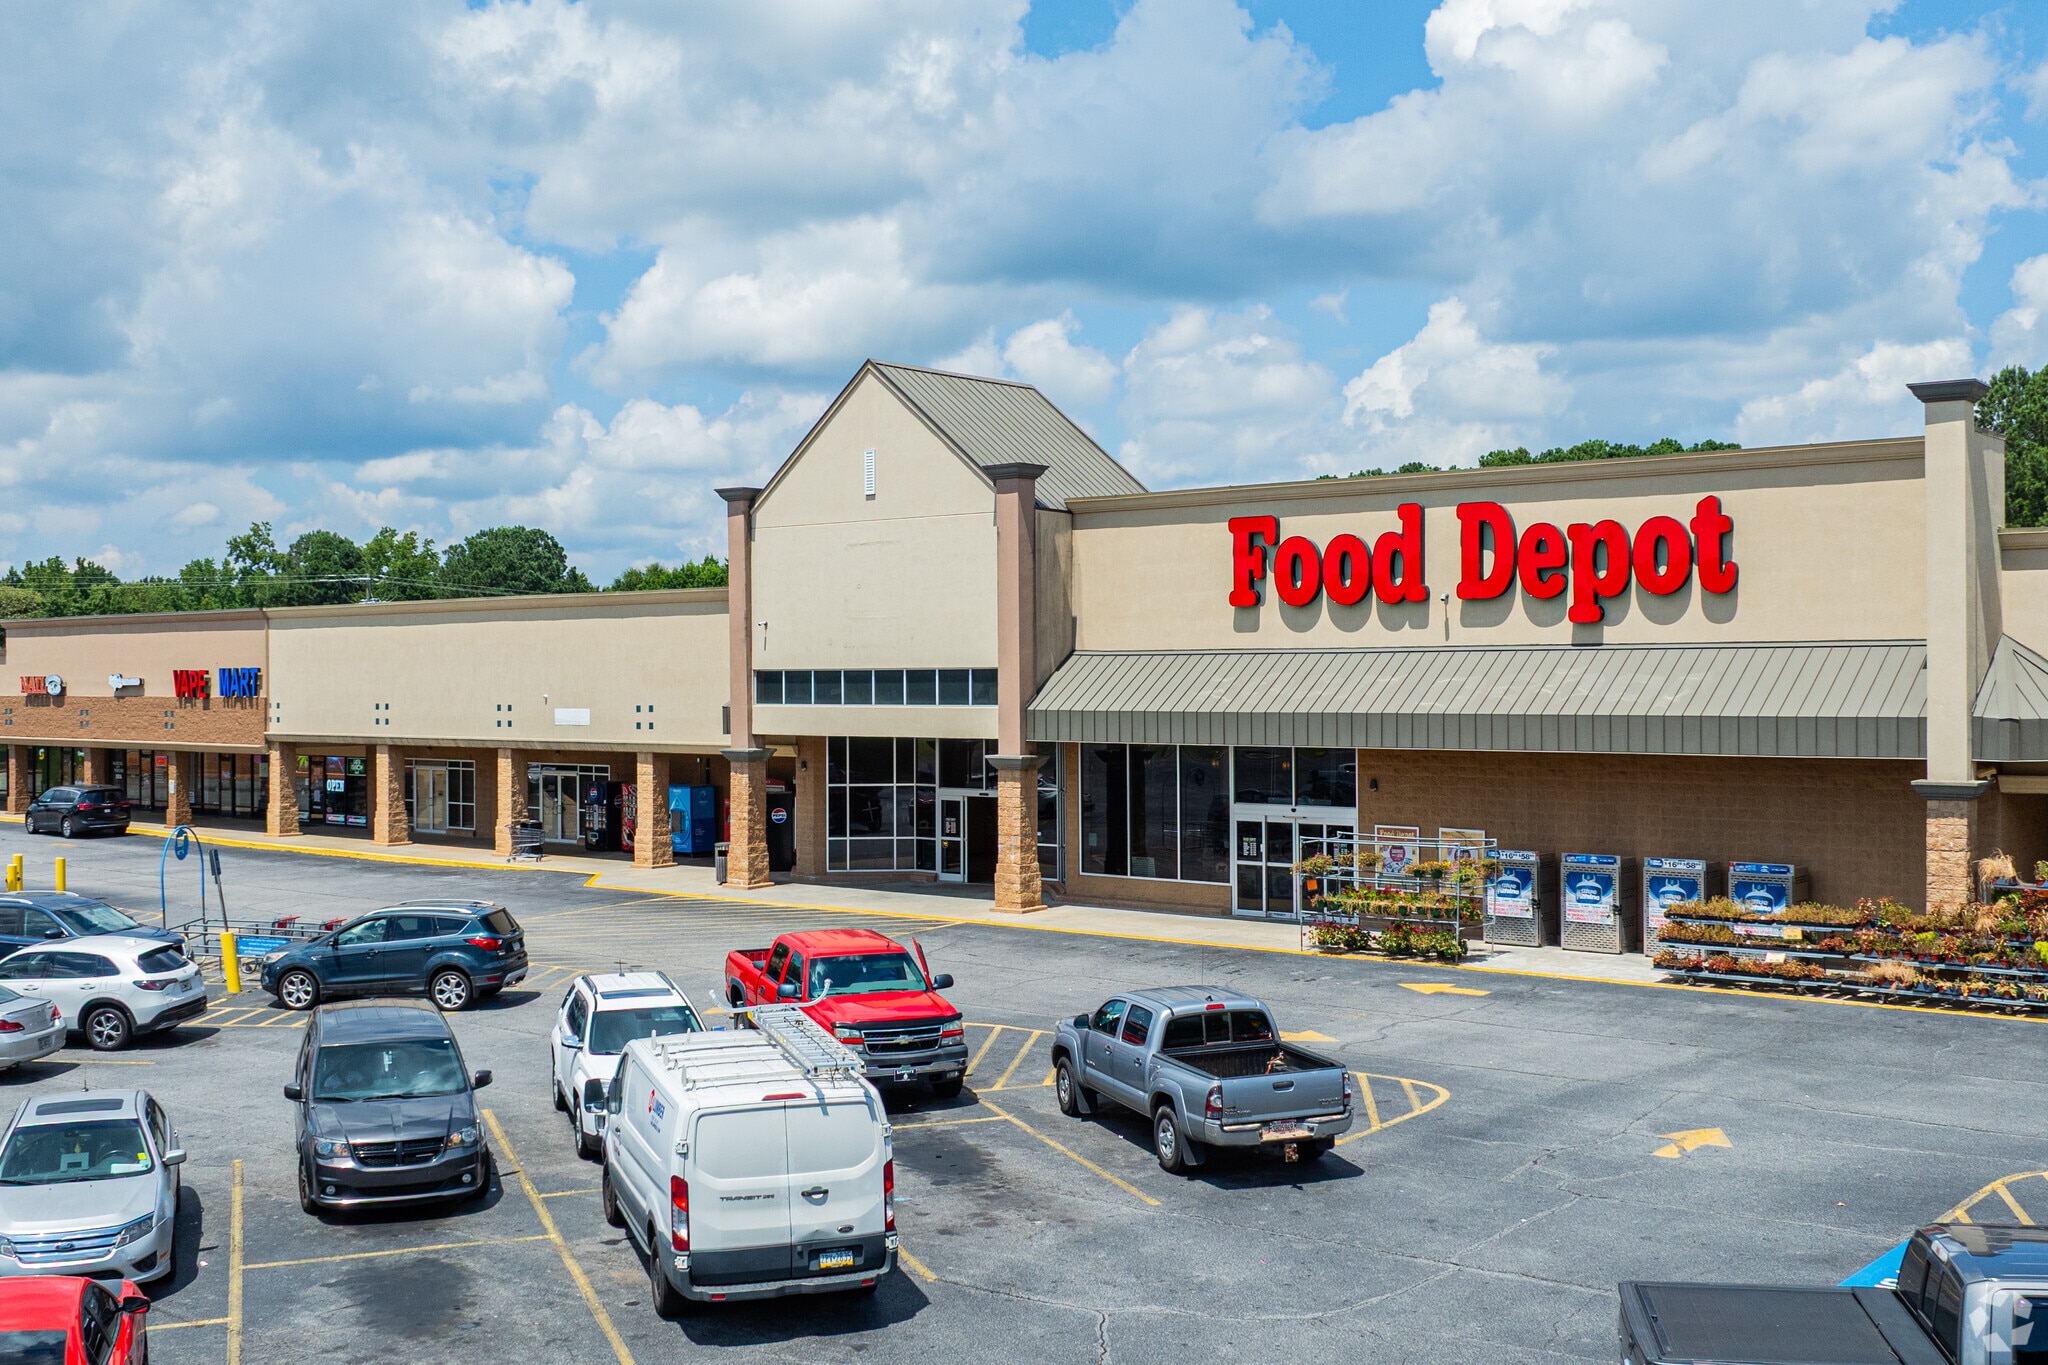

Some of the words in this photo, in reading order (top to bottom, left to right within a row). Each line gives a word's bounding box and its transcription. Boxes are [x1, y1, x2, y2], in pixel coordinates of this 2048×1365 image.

[1228, 502, 1430, 607] Food
[1456, 495, 1738, 623] Depot
[172, 669, 209, 699] VAPE
[218, 667, 262, 697] MART
[326, 779, 345, 792] OPEN
[719, 1194, 762, 1202] TRANSIT
